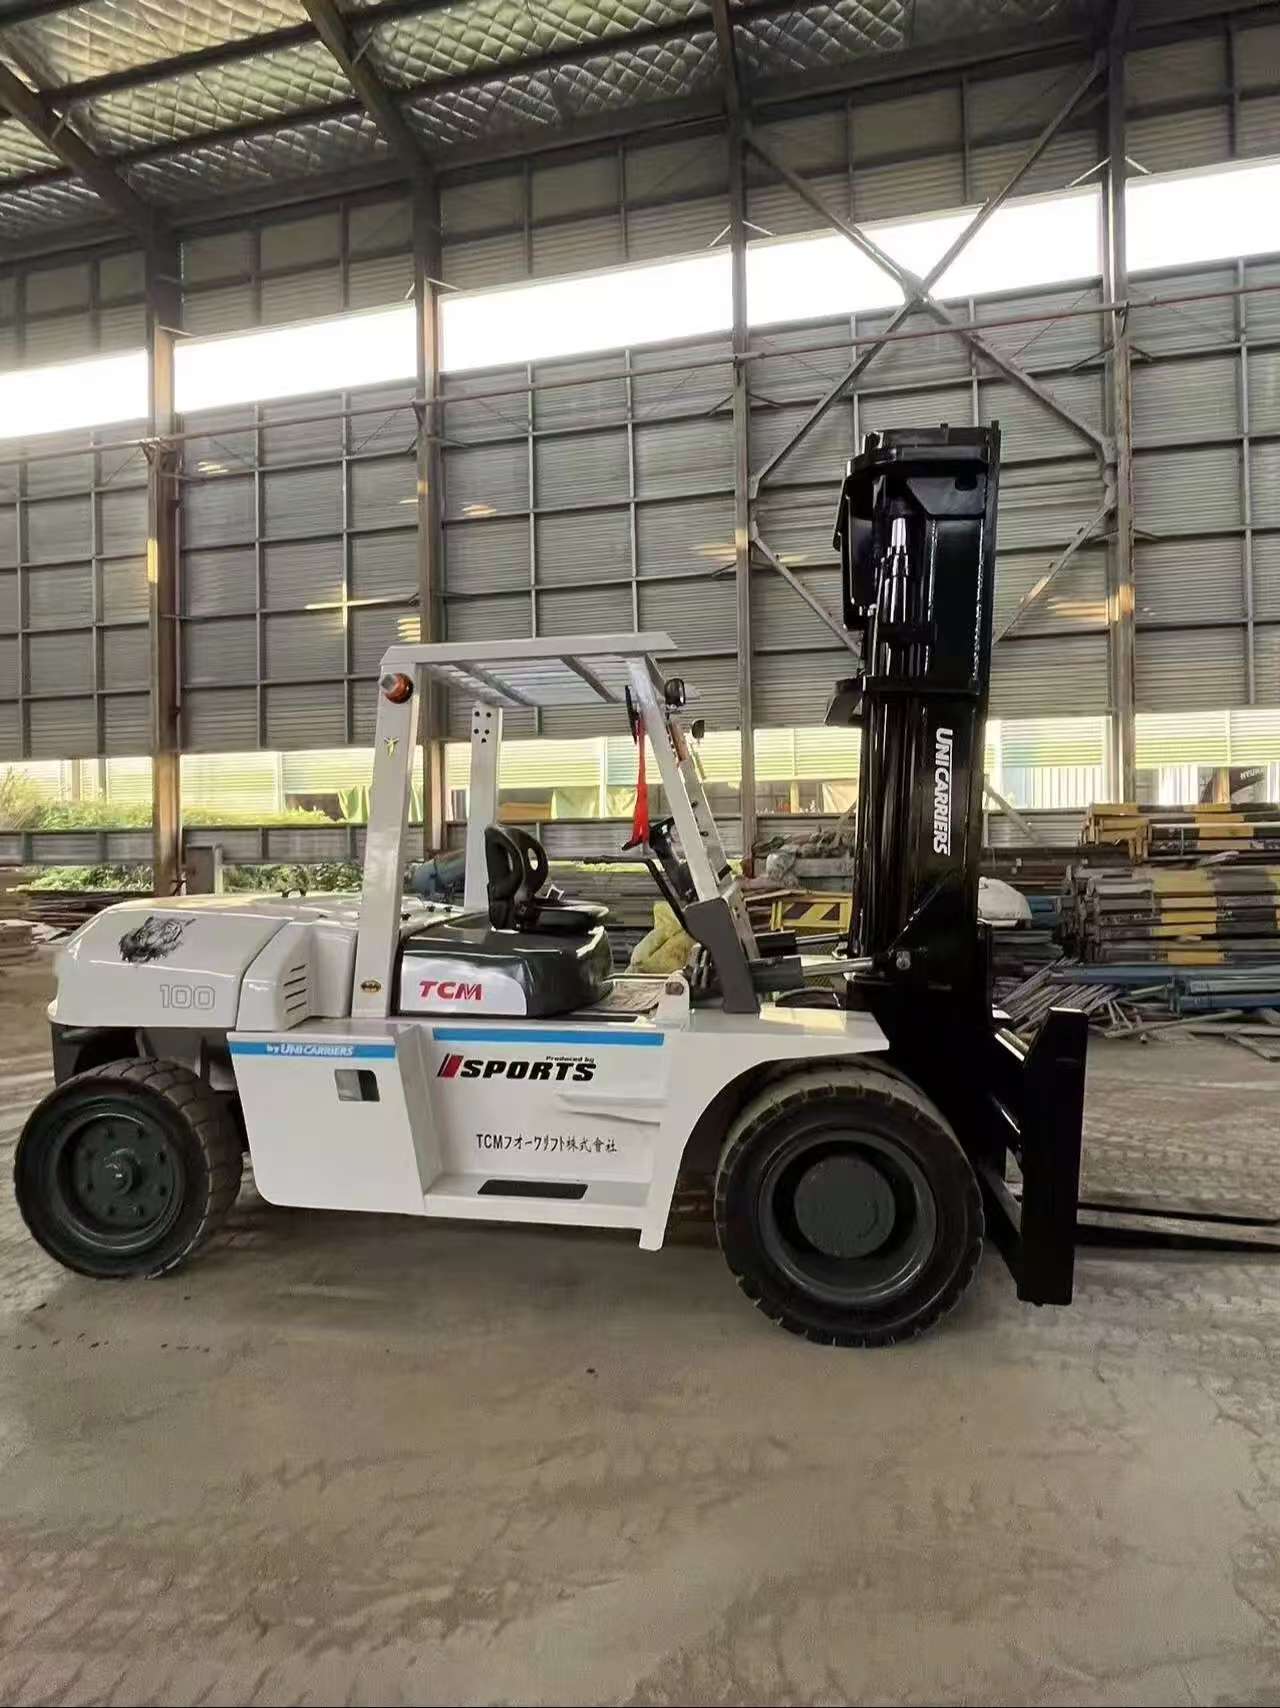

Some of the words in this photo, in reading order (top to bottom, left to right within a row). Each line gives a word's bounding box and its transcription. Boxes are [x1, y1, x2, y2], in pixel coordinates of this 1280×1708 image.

[934, 727, 953, 856] UNICARRIERS
[159, 984, 216, 1010] 100
[419, 981, 482, 1000] TCM
[266, 1043, 280, 1055] by
[280, 1043, 353, 1056] UNICARRIERS
[584, 1056, 595, 1064] by
[460, 1060, 597, 1081] SPORTS
